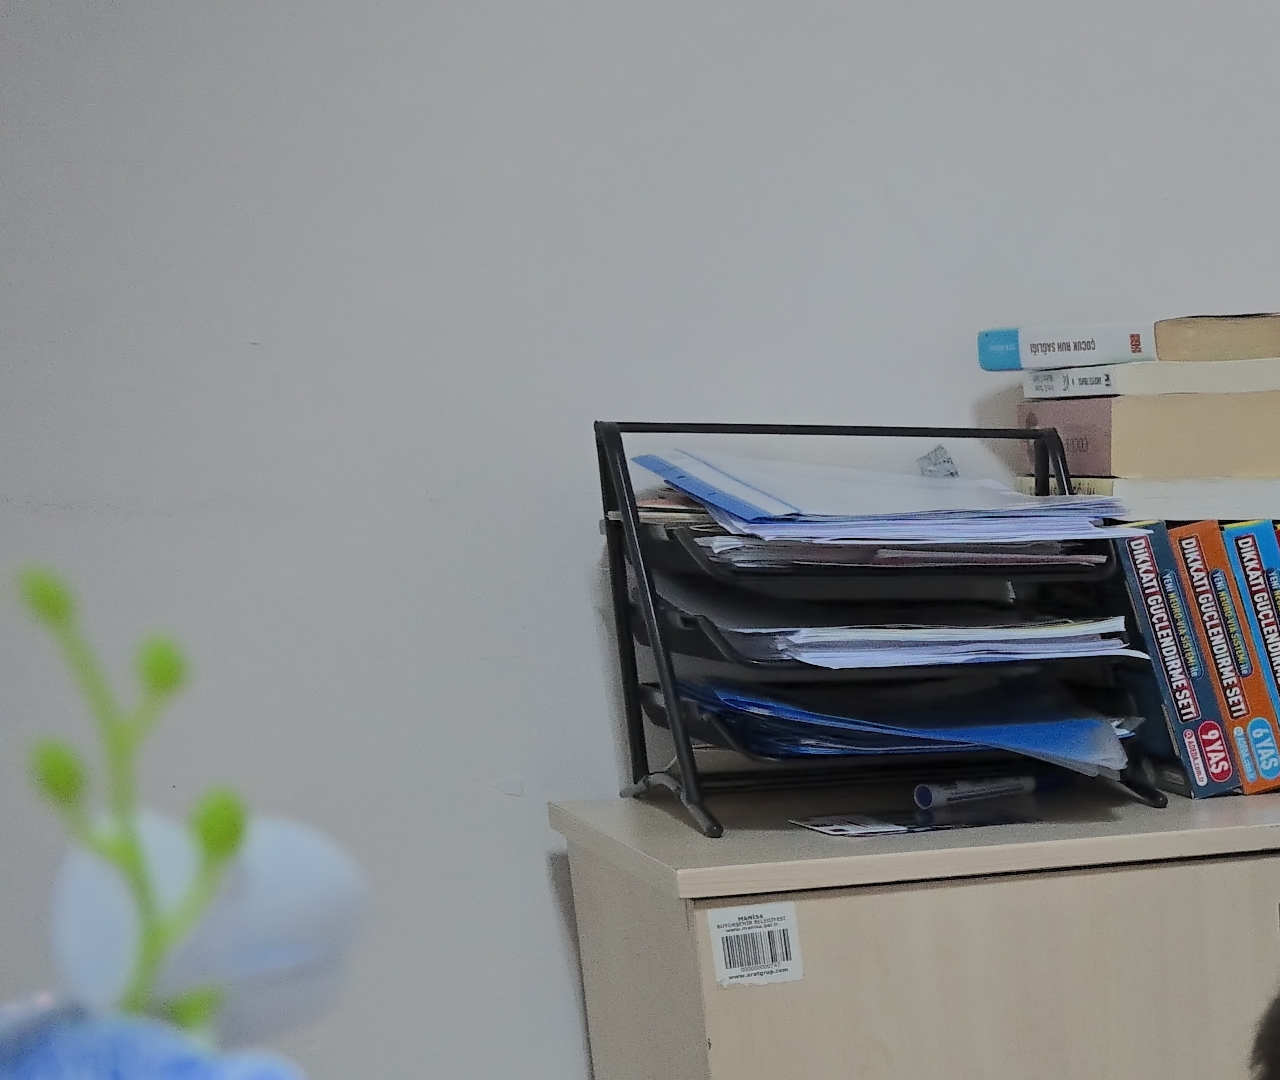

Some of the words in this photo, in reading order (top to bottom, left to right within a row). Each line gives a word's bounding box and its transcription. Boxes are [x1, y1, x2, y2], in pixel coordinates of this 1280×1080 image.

[1057, 341, 1072, 352] RUH
[1200, 729, 1219, 742] 9
[1251, 726, 1269, 738] 6
